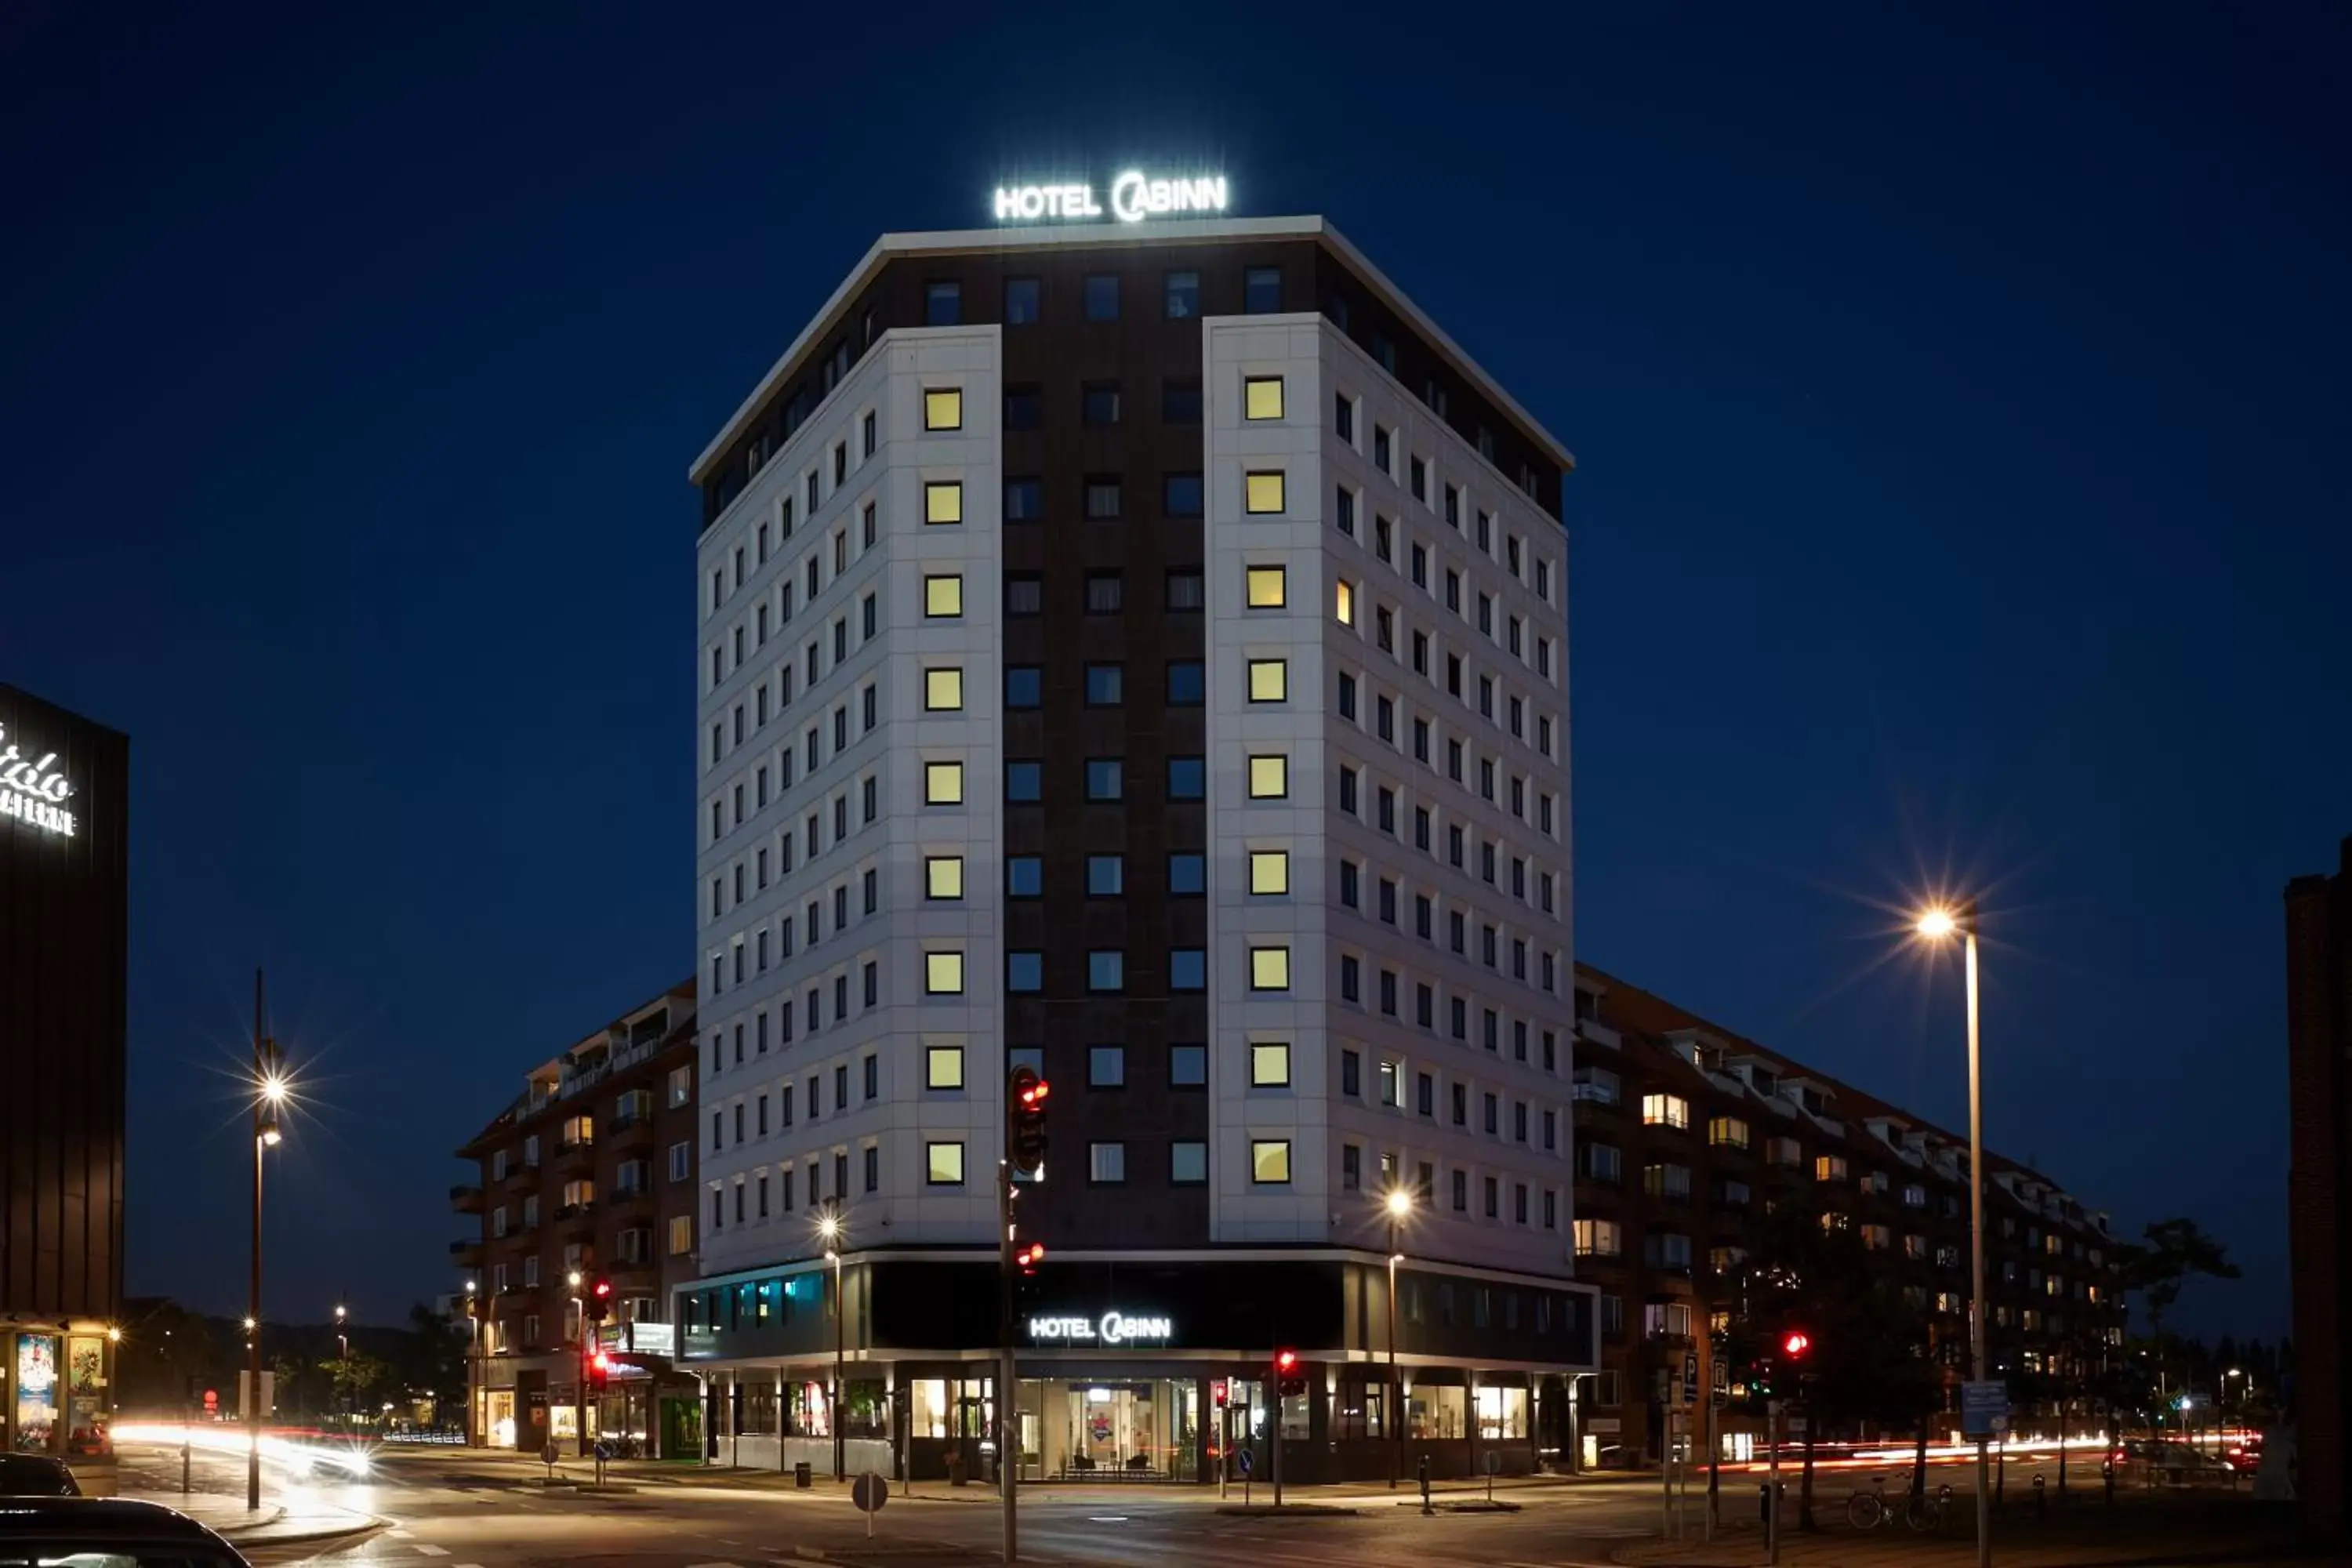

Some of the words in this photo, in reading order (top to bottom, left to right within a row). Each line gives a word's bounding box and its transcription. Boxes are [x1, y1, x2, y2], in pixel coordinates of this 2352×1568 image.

[995, 185, 1101, 219] HOTEL
[1112, 170, 1226, 223] CABINN
[1031, 1318, 1095, 1337] HOTEL
[1100, 1312, 1170, 1342] CABINN
